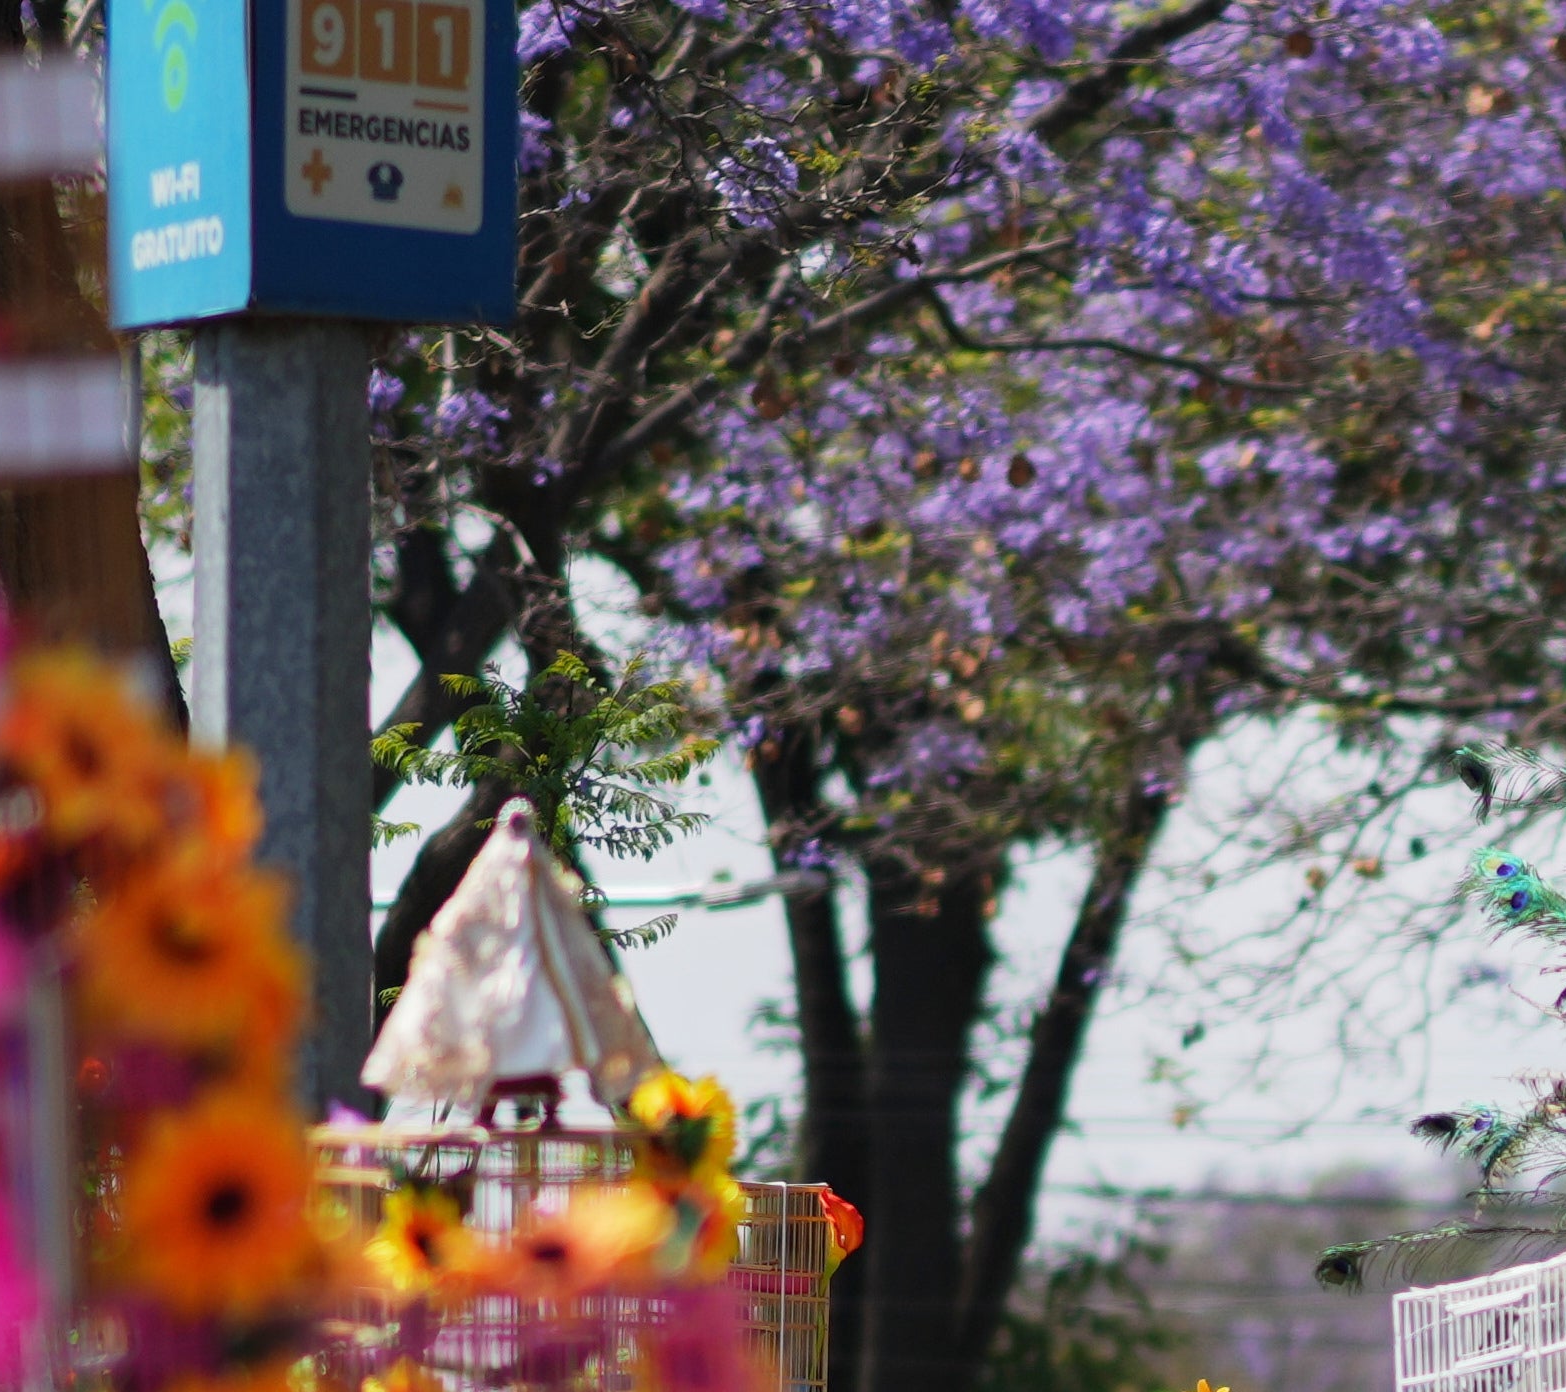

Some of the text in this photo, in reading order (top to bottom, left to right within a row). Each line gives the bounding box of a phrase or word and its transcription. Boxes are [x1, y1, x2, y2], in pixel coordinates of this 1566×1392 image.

[312, 4, 453, 77] 911
[299, 108, 470, 151] EMERGENCIAS
[151, 161, 200, 207] WI-FI
[131, 216, 223, 270] GRATUITO
